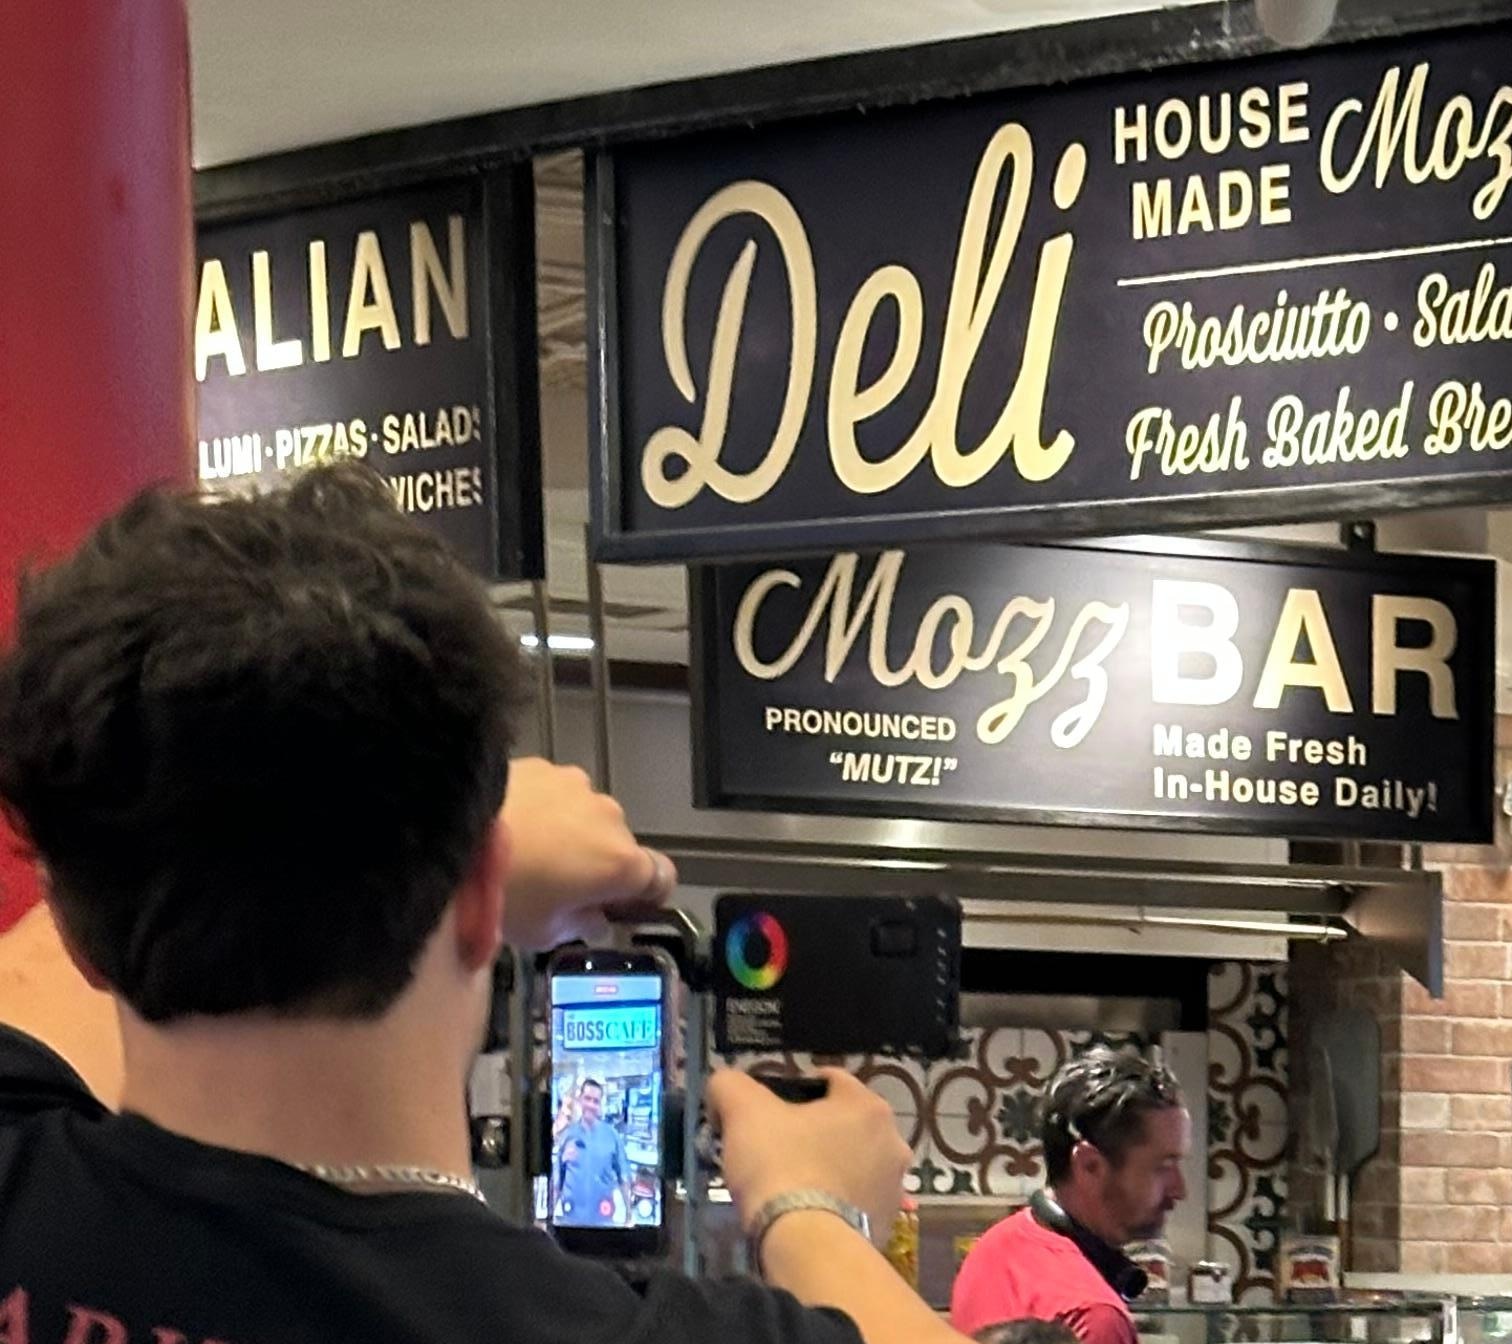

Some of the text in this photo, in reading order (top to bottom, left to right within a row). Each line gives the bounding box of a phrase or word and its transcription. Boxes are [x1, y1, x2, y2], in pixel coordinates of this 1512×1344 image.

[1113, 81, 1310, 164] HOUSE
[1131, 164, 1292, 240] MADE
[641, 122, 1087, 508] Deli
[1143, 286, 1370, 374] Prosciutto
[1125, 396, 1249, 480] Fresh
[1262, 381, 1414, 469] Baked
[733, 549, 1460, 749] Mozz BAR
[765, 707, 957, 742] PRONOUNCED
[1152, 724, 1367, 766] Made Fresh
[1153, 767, 1437, 818] In-House Daily!
